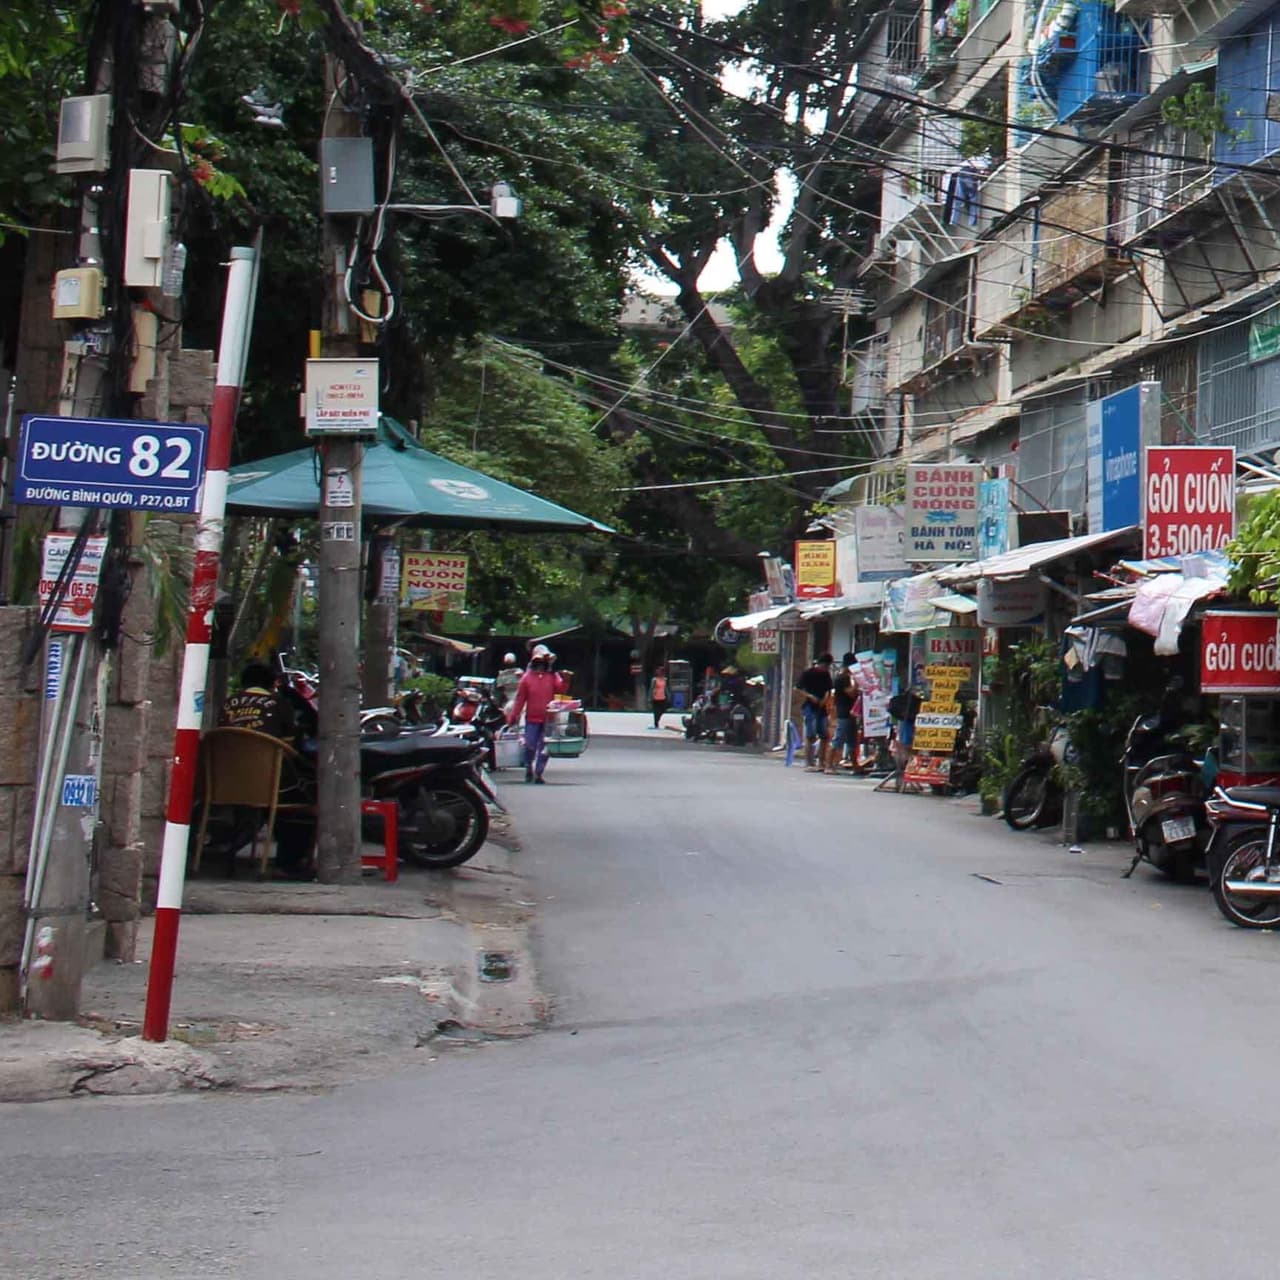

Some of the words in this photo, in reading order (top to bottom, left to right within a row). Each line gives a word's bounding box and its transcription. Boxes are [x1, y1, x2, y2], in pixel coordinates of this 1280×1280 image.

[31, 441, 121, 465] ĐƯỜNG
[128, 435, 192, 479] 82
[26, 487, 70, 501] ĐƯỜNG
[71, 489, 100, 503] BÌNH
[1149, 457, 1179, 514] GỎI
[1184, 457, 1233, 514] CUỐN
[1206, 632, 1236, 671] GỎI
